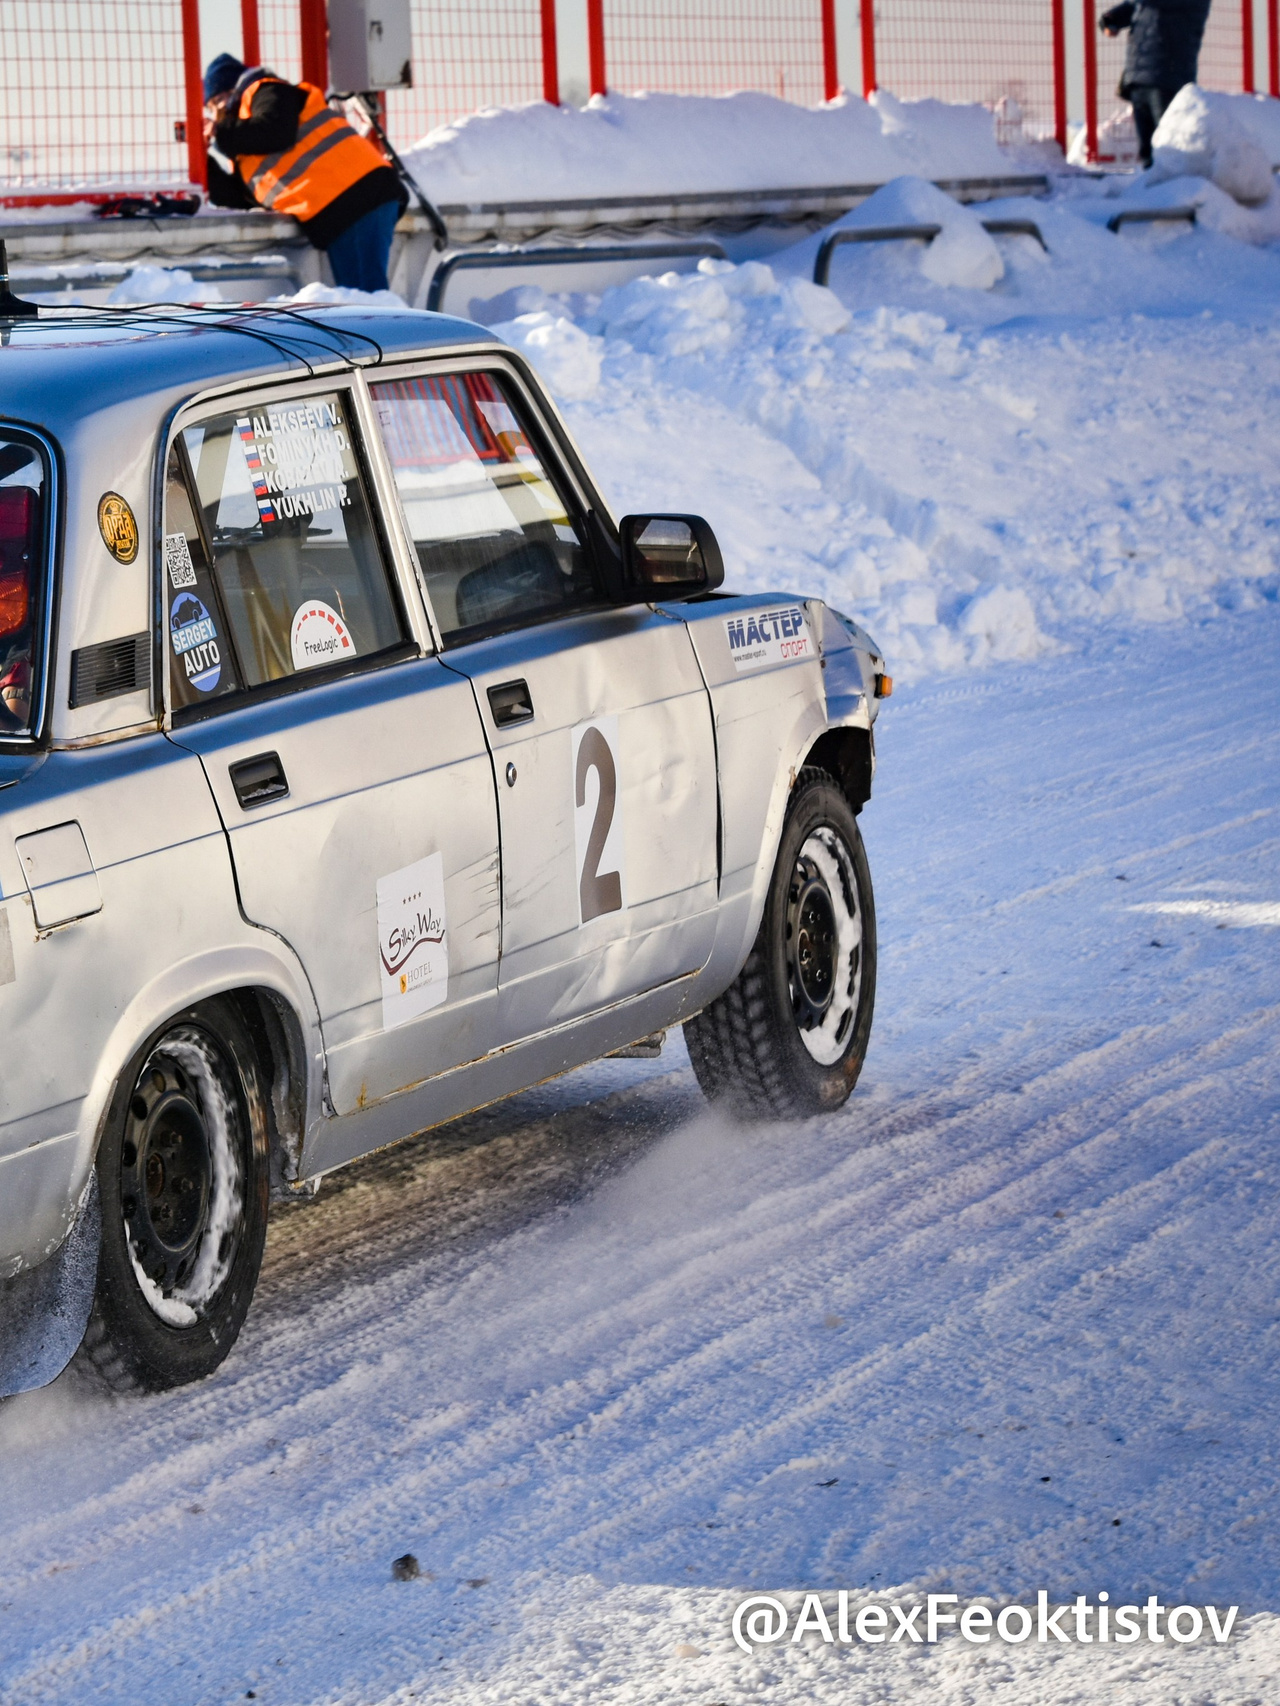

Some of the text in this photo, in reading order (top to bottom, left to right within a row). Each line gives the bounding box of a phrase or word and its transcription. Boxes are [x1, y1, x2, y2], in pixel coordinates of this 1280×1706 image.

[253, 403, 341, 439] ALEKSEEV V.
[257, 430, 351, 467] FOMINYKH D.
[271, 485, 352, 520] YUKHLIN P.
[171, 620, 216, 653] SERGEY
[304, 637, 339, 656] FreeLogic
[727, 608, 803, 650] МАСТЕР
[183, 640, 221, 678] AUTO
[780, 639, 808, 659] СПОРТ
[575, 726, 623, 925] 2
[388, 908, 442, 962] Silky Way
[407, 961, 433, 985] HOTEL
